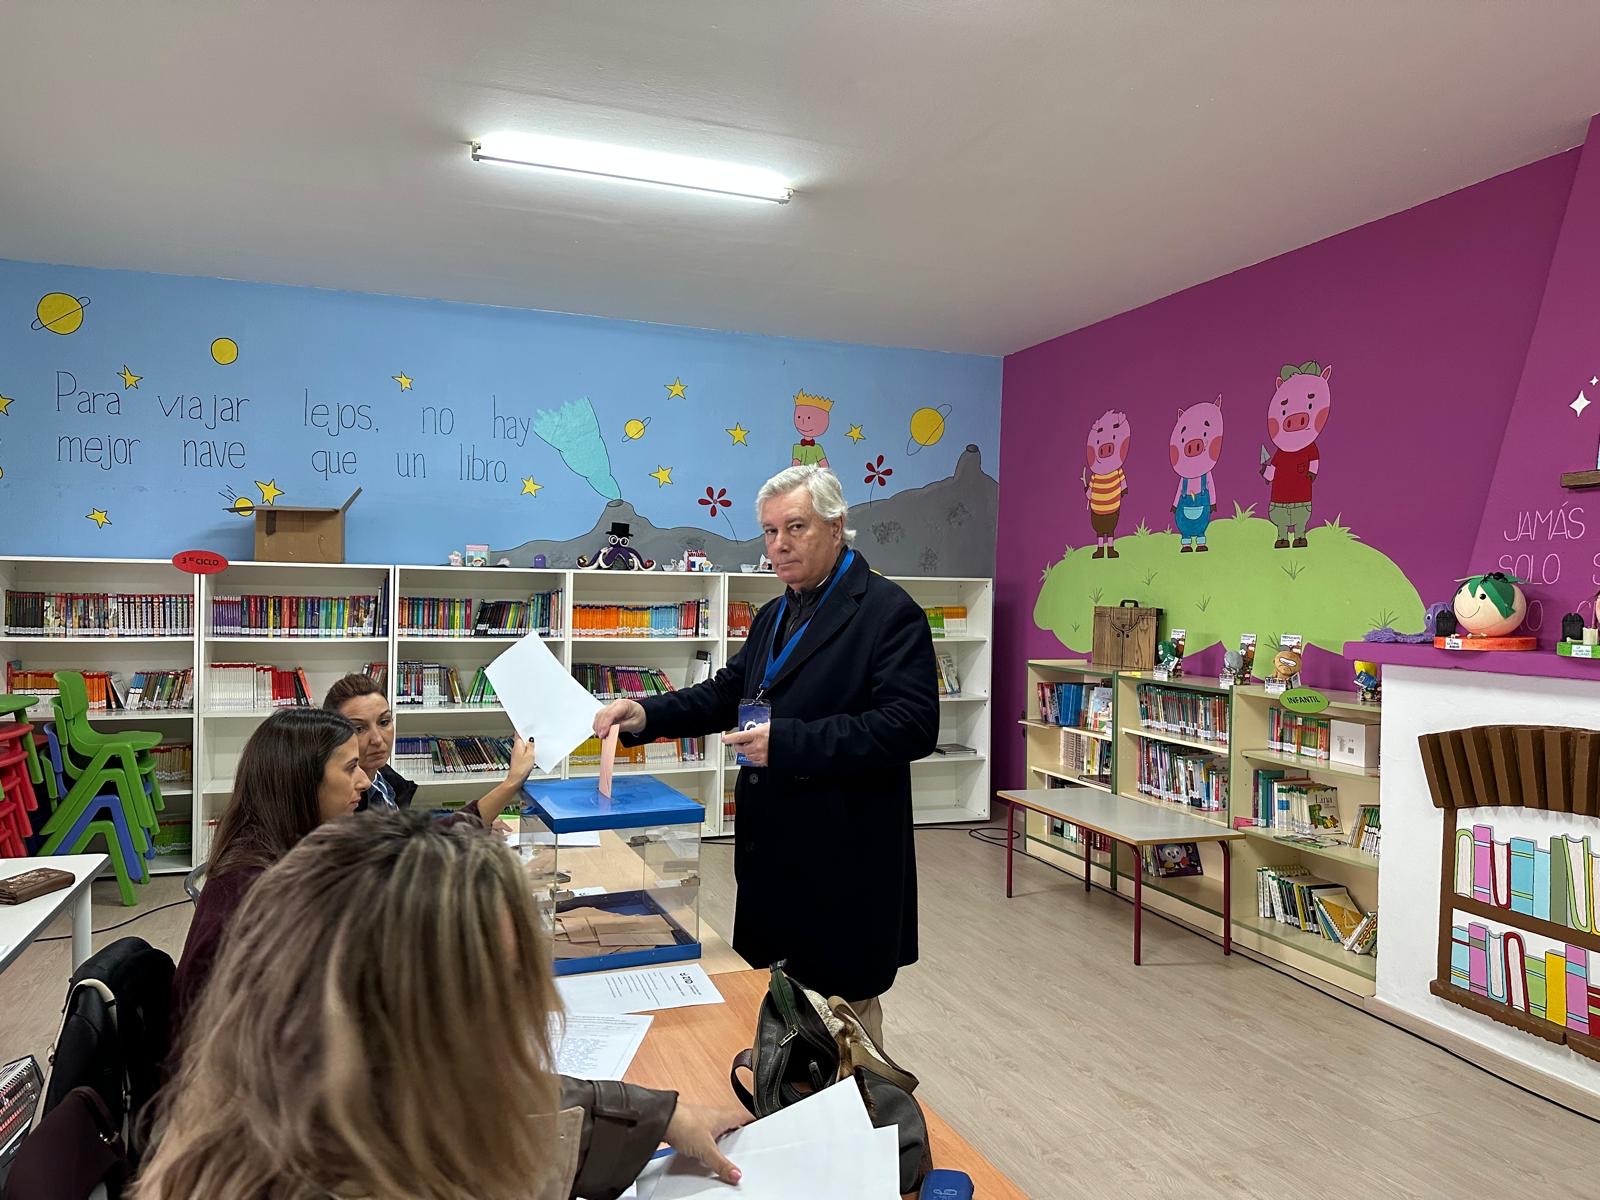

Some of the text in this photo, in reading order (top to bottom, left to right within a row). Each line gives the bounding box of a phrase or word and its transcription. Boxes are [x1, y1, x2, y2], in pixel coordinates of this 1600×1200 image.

[56, 371, 531, 448] Para viajar lejos, no hay
[57, 434, 508, 483] mejor nave que un libro.
[1503, 500, 1586, 542] JAMÁS
[195, 558, 219, 566] CICLO
[1498, 553, 1561, 585] SOLO
[1286, 695, 1321, 704] INFANTIL
